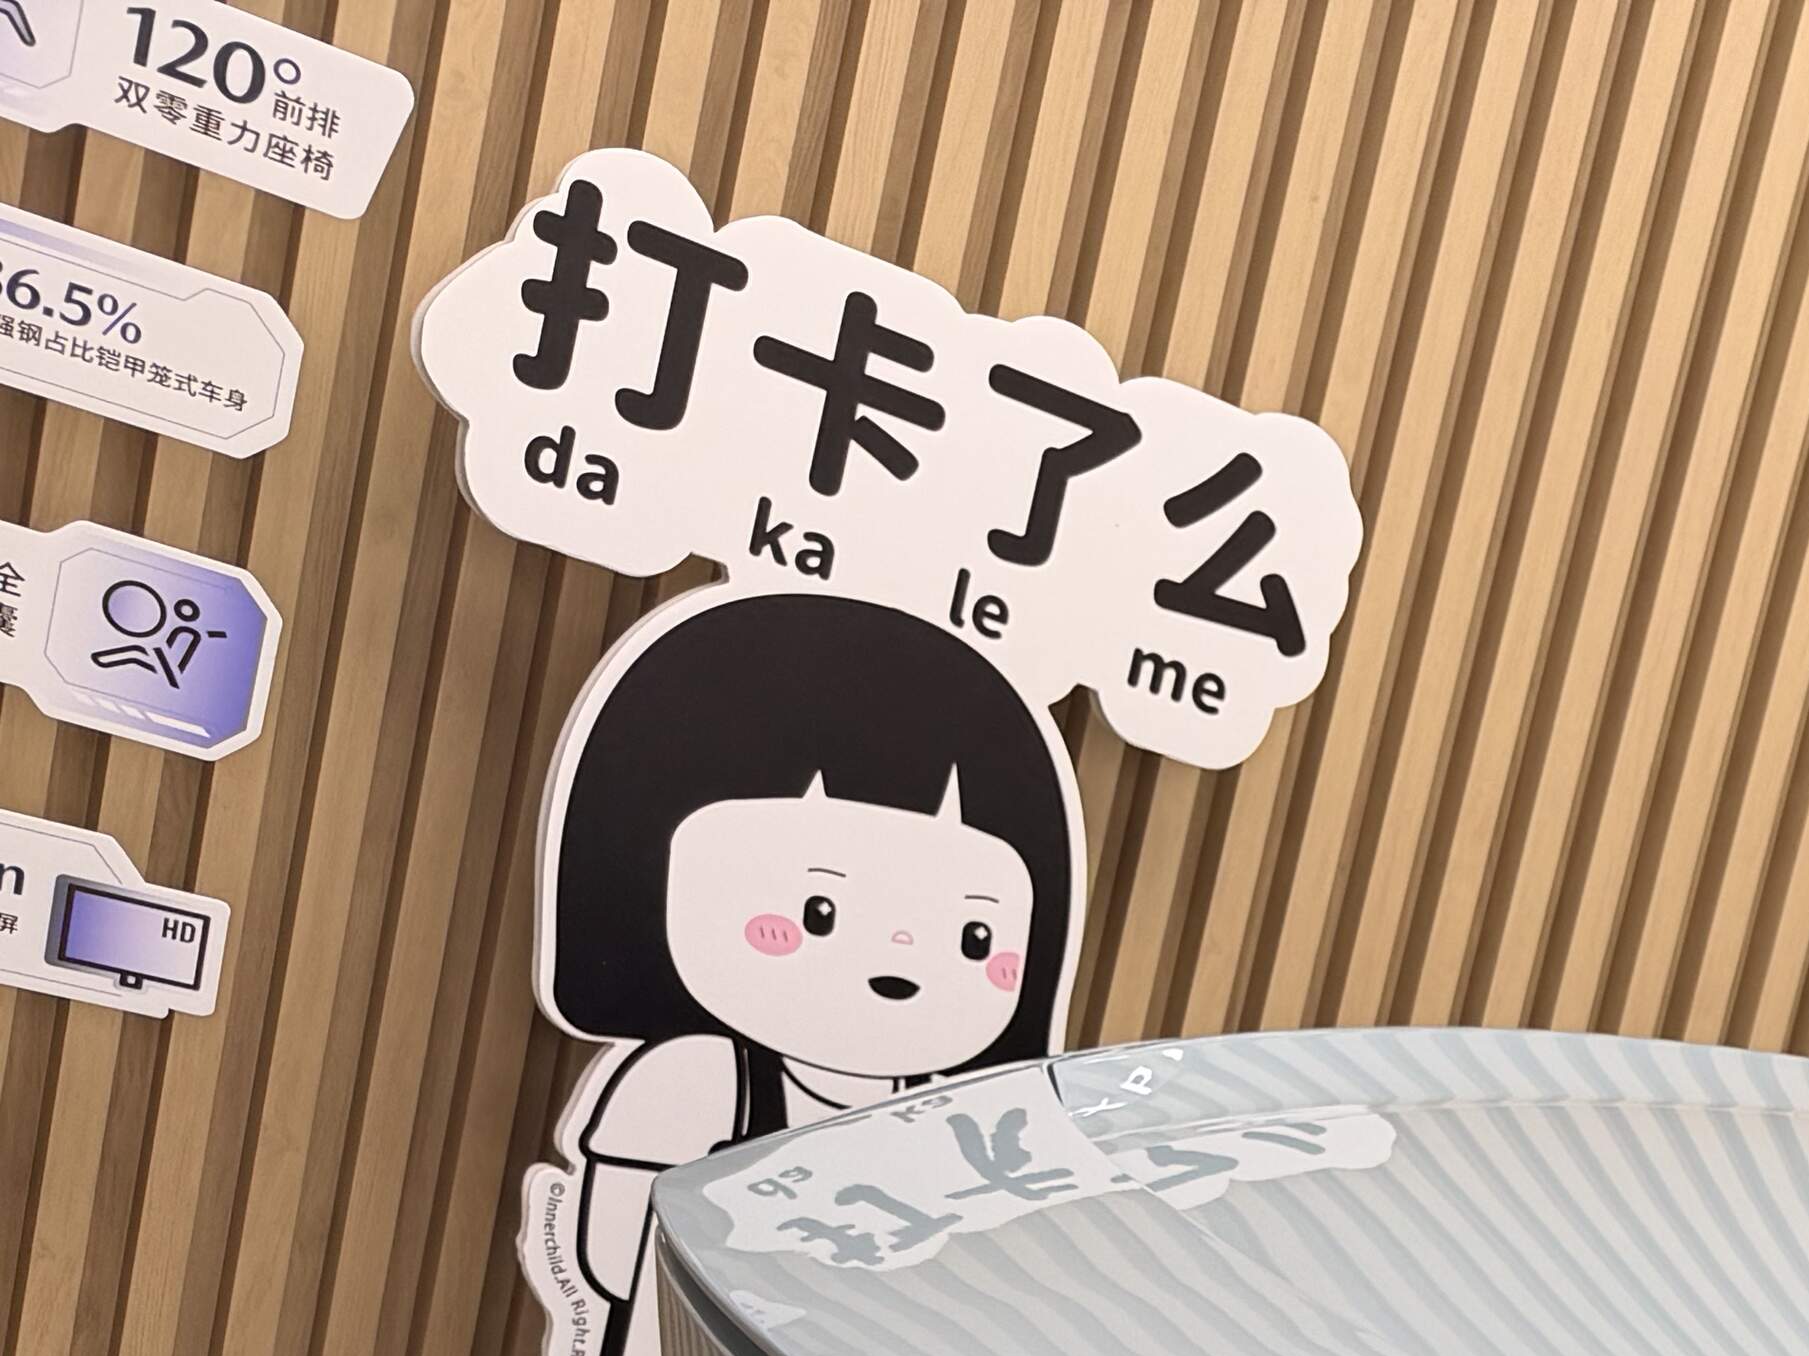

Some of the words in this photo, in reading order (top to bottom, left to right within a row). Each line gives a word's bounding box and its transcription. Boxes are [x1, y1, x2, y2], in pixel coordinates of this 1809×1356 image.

[114, 76, 335, 181] 双零重力座椅
[126, 6, 301, 104] 120°
[272, 90, 341, 139] 前排
[0, 261, 142, 344] 6.5%
[513, 180, 1306, 657] 打卡了么
[523, 426, 620, 506] da
[748, 497, 836, 580] ka
[949, 569, 1009, 640] le
[1127, 647, 1228, 716] me
[162, 917, 197, 944] HD
